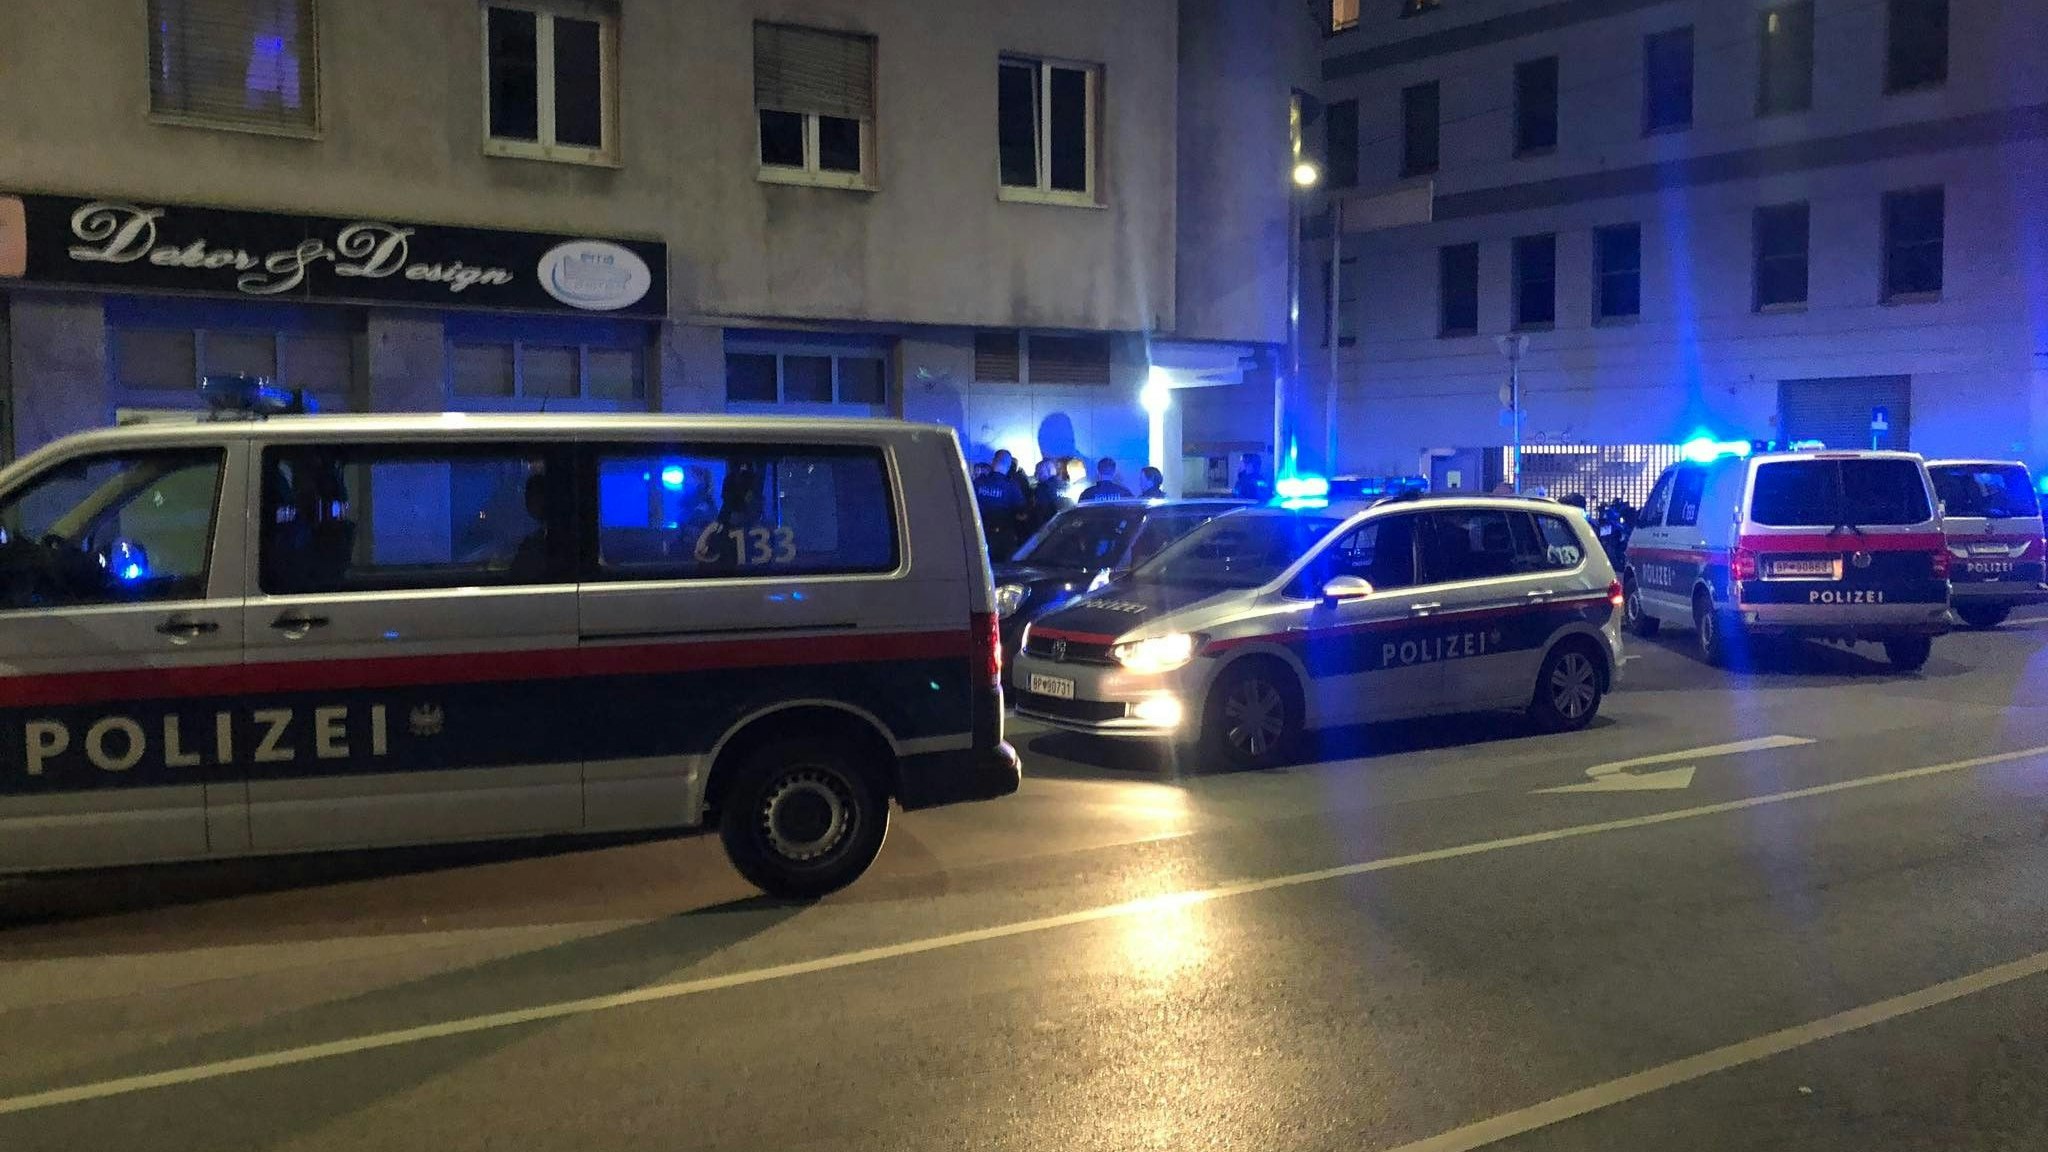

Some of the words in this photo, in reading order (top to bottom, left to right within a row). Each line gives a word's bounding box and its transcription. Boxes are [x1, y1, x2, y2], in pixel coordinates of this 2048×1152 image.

[334, 221, 514, 293] Design
[728, 526, 797, 565] 133
[1967, 562, 2014, 573] POLIZEI
[1809, 590, 1883, 604] POLIZEI
[1382, 631, 1486, 667] POLIZEI
[25, 703, 388, 776] POLIZEI
